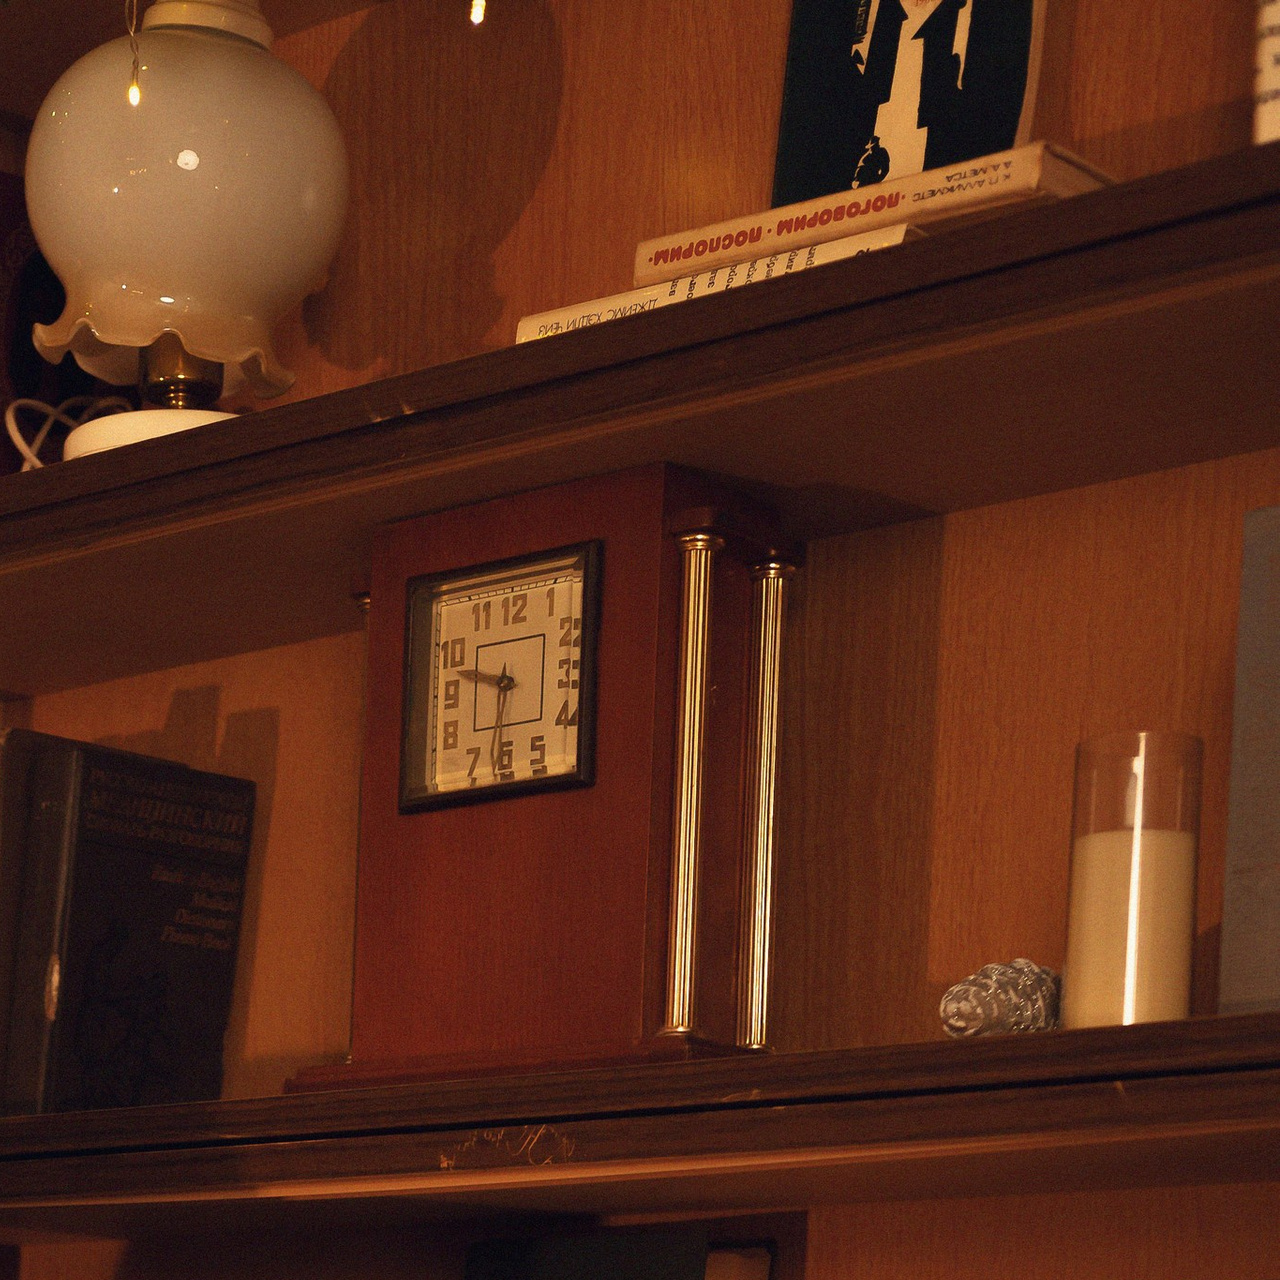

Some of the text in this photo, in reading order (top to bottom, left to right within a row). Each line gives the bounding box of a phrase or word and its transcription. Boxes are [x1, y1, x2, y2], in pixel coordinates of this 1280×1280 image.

[656, 191, 901, 264] ПОГОВОРИМ ПОСПОРИМ
[472, 600, 491, 632] 11
[501, 593, 527, 626] 12
[546, 587, 556, 617] 1
[559, 616, 572, 648] 2
[441, 637, 467, 669] 10
[558, 658, 570, 690] 3
[444, 679, 460, 710] 9
[555, 699, 570, 730] 4
[443, 720, 459, 751] 8
[530, 735, 545, 766] 5
[466, 747, 481, 777] 7
[498, 740, 514, 771] 6
